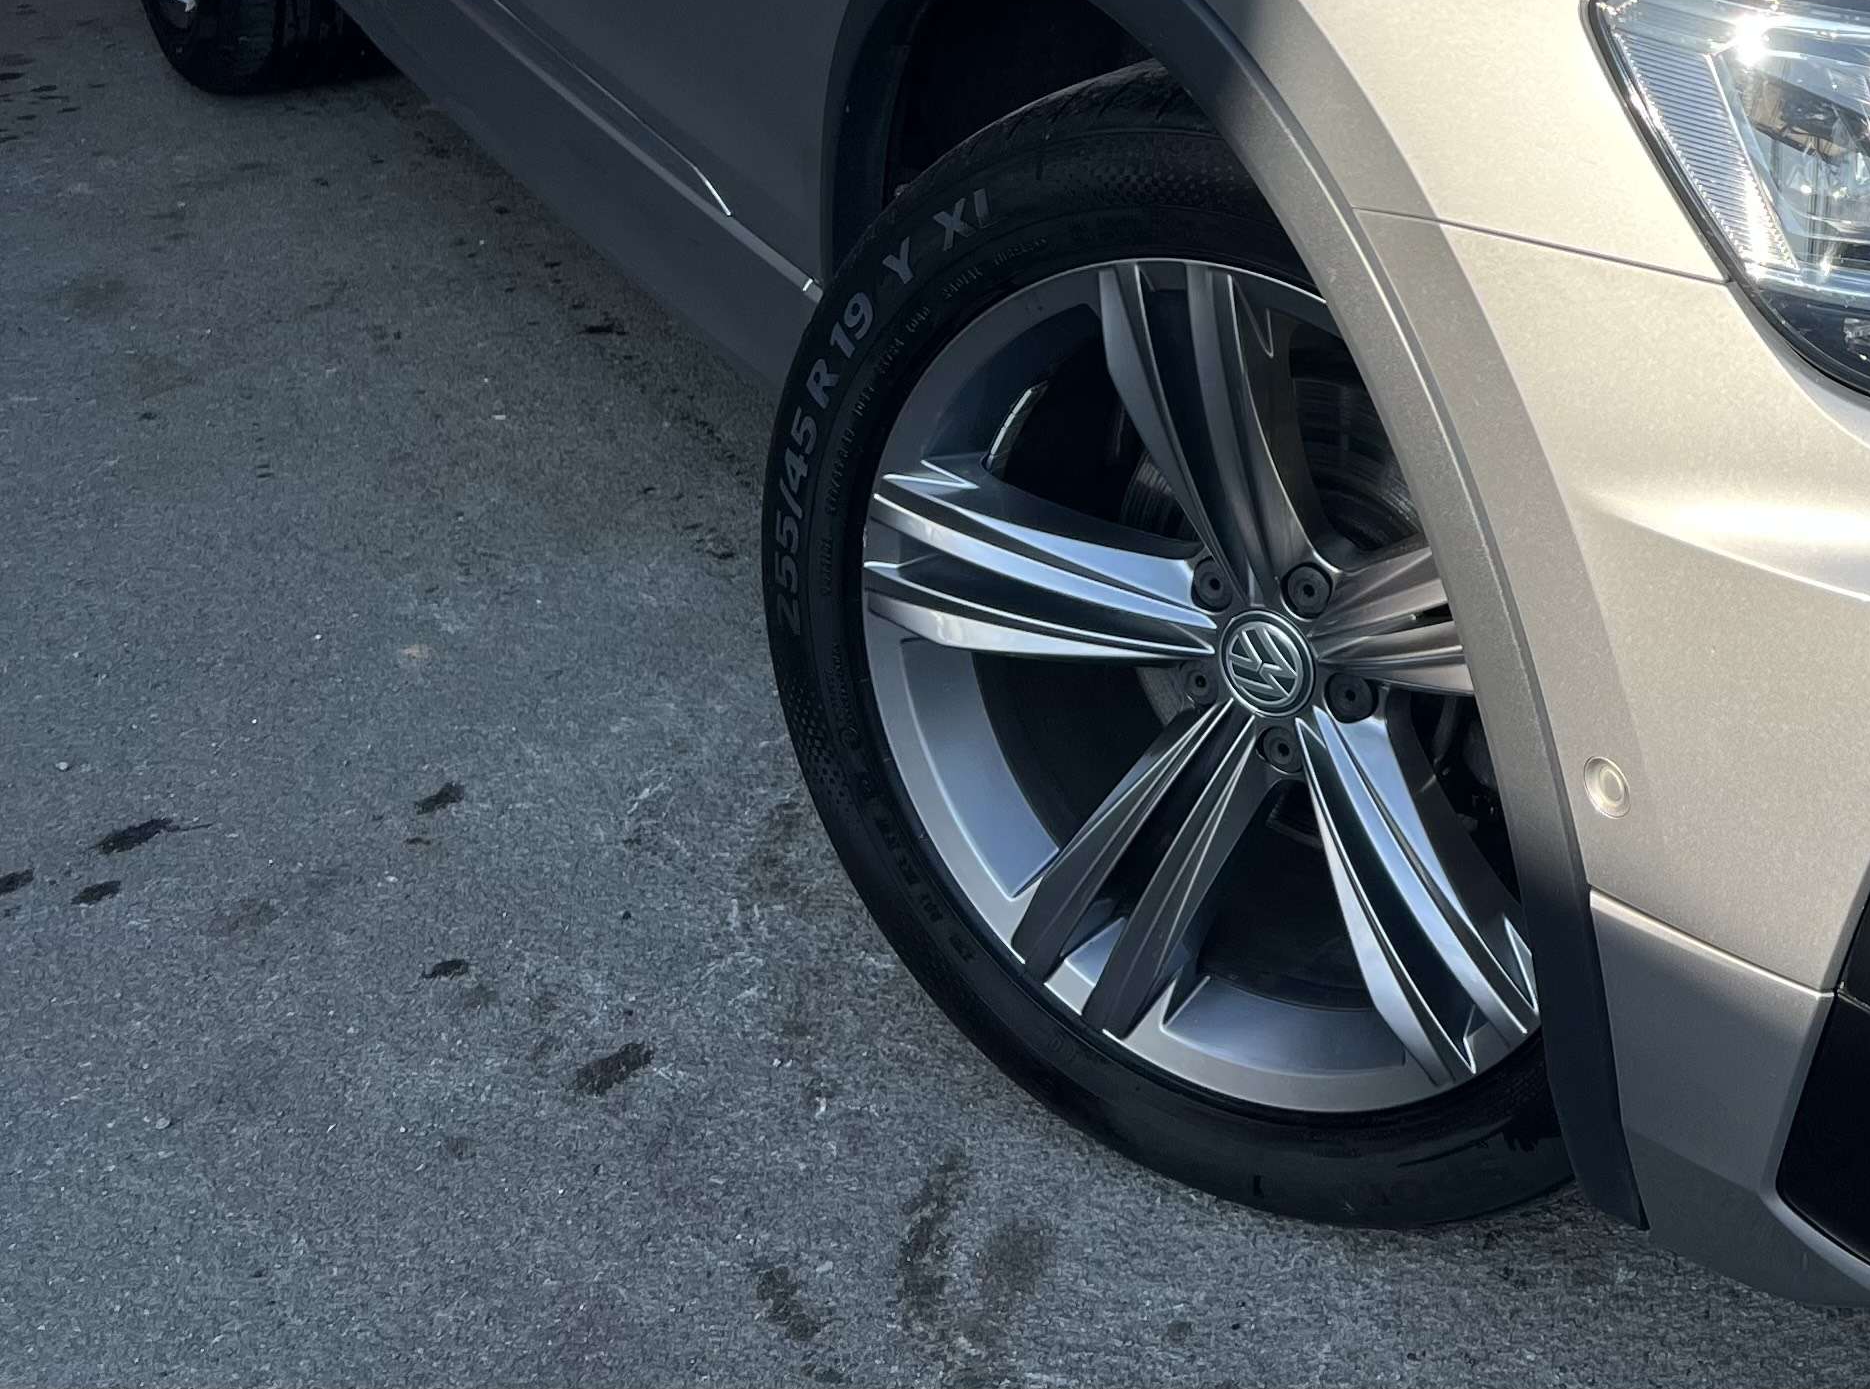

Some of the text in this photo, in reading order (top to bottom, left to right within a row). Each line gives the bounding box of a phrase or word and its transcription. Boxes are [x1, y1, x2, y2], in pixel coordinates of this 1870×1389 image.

[773, 406, 818, 639] 255/45
[805, 358, 840, 410] R
[829, 292, 874, 359] 19
[882, 236, 914, 285] Y
